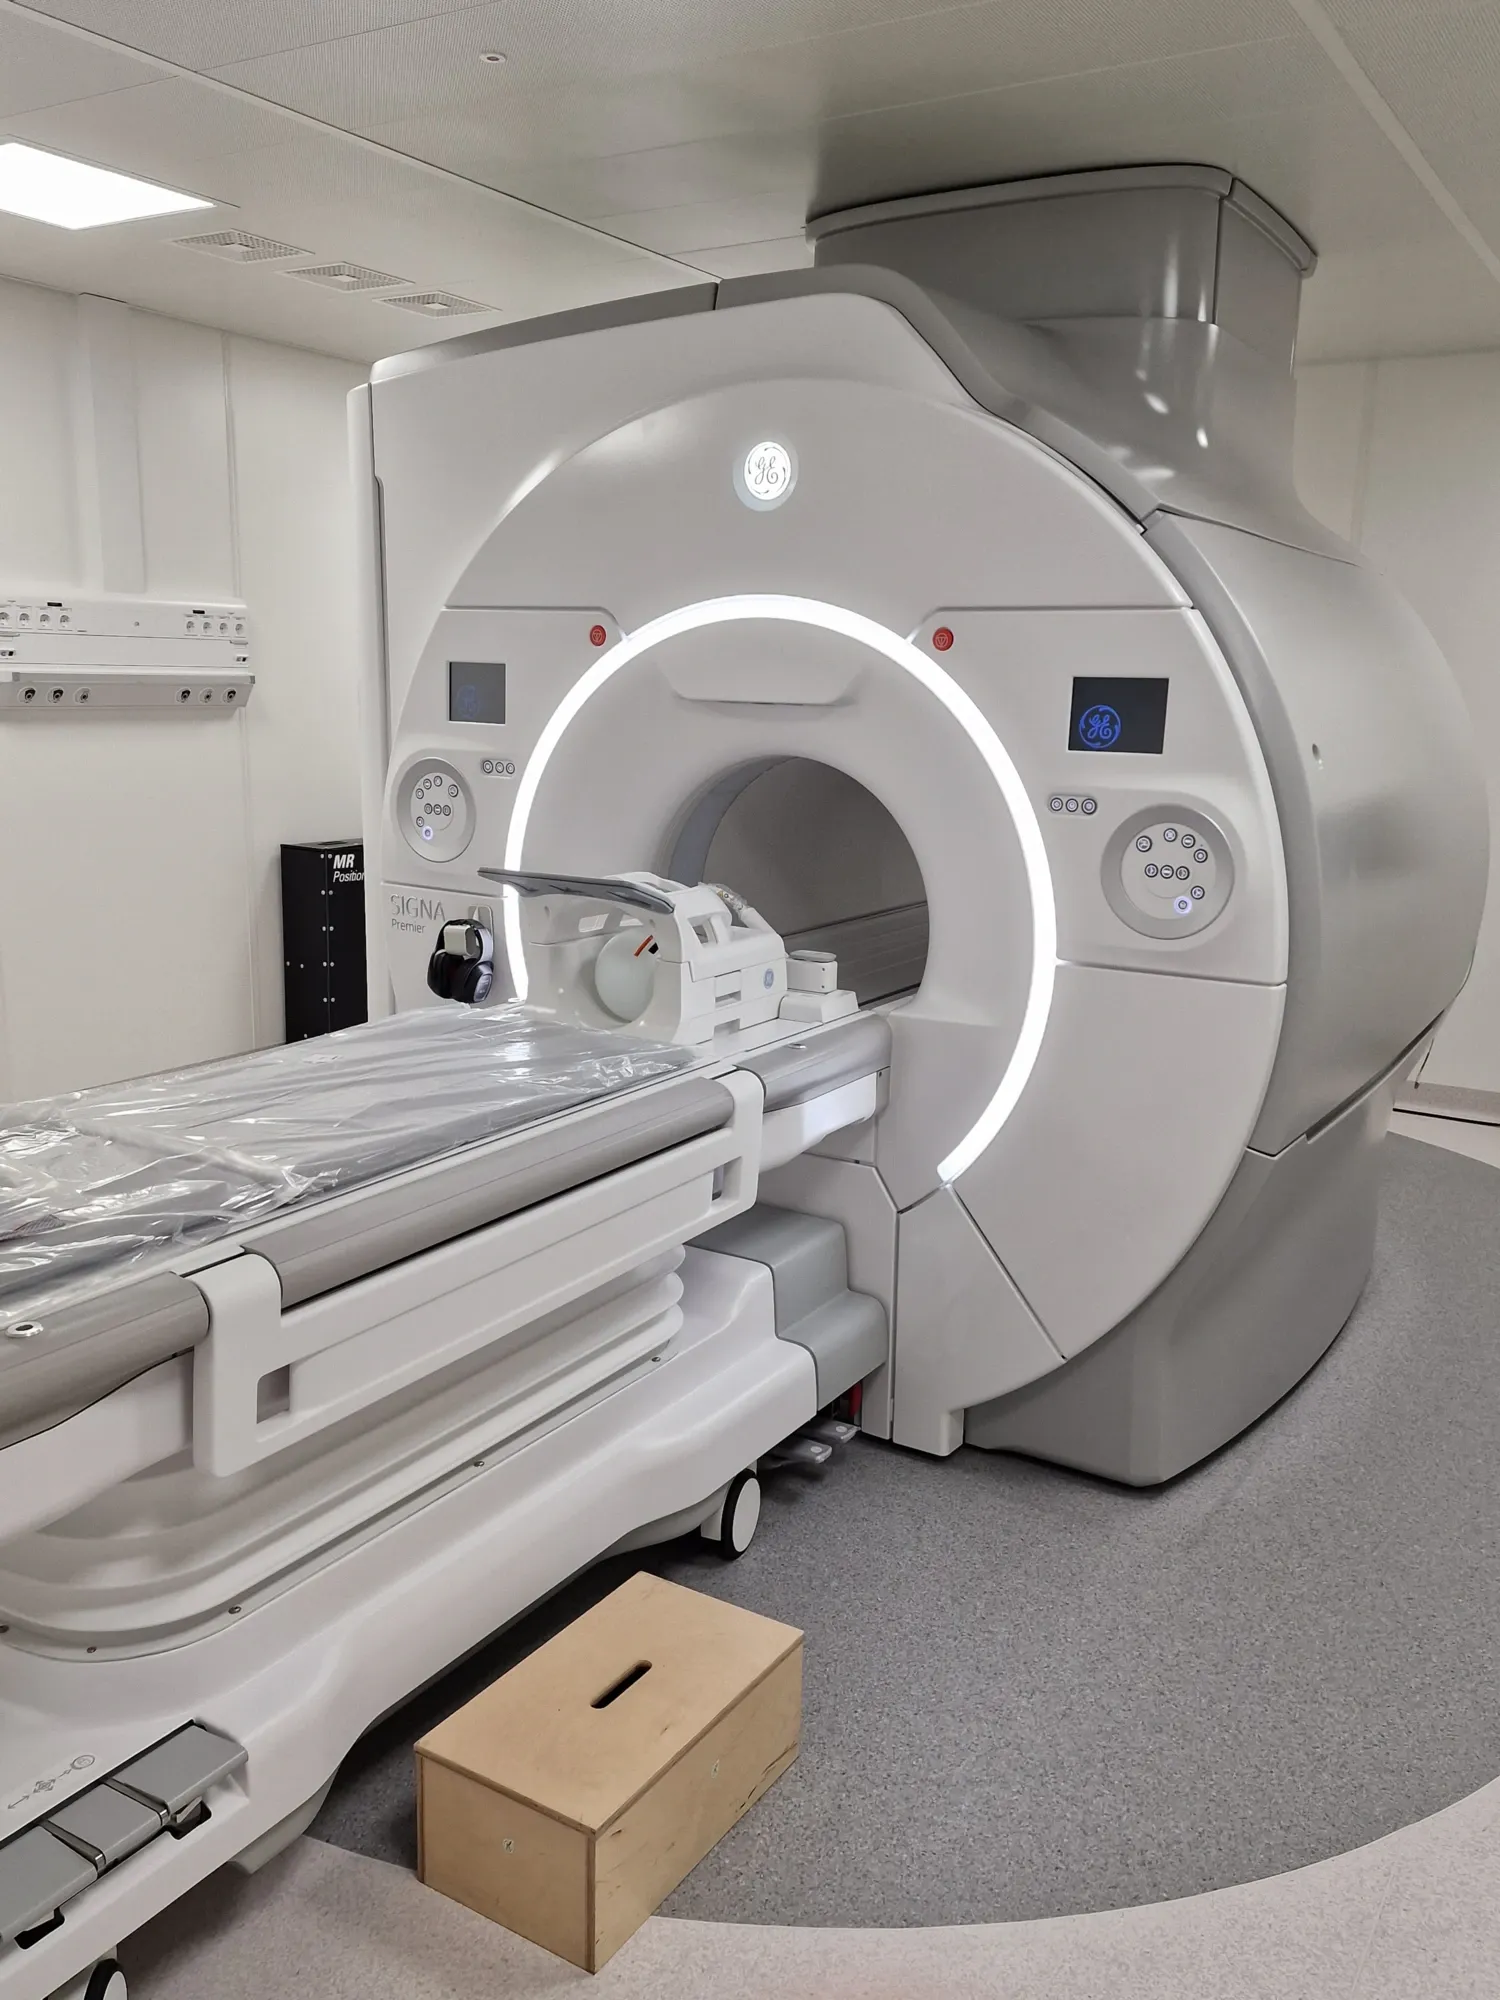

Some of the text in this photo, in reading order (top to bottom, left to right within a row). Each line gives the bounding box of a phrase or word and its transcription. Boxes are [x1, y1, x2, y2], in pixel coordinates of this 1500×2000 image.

[332, 853, 355, 869] MR
[390, 894, 446, 922] SIGNA
[391, 918, 426, 934] Premier
